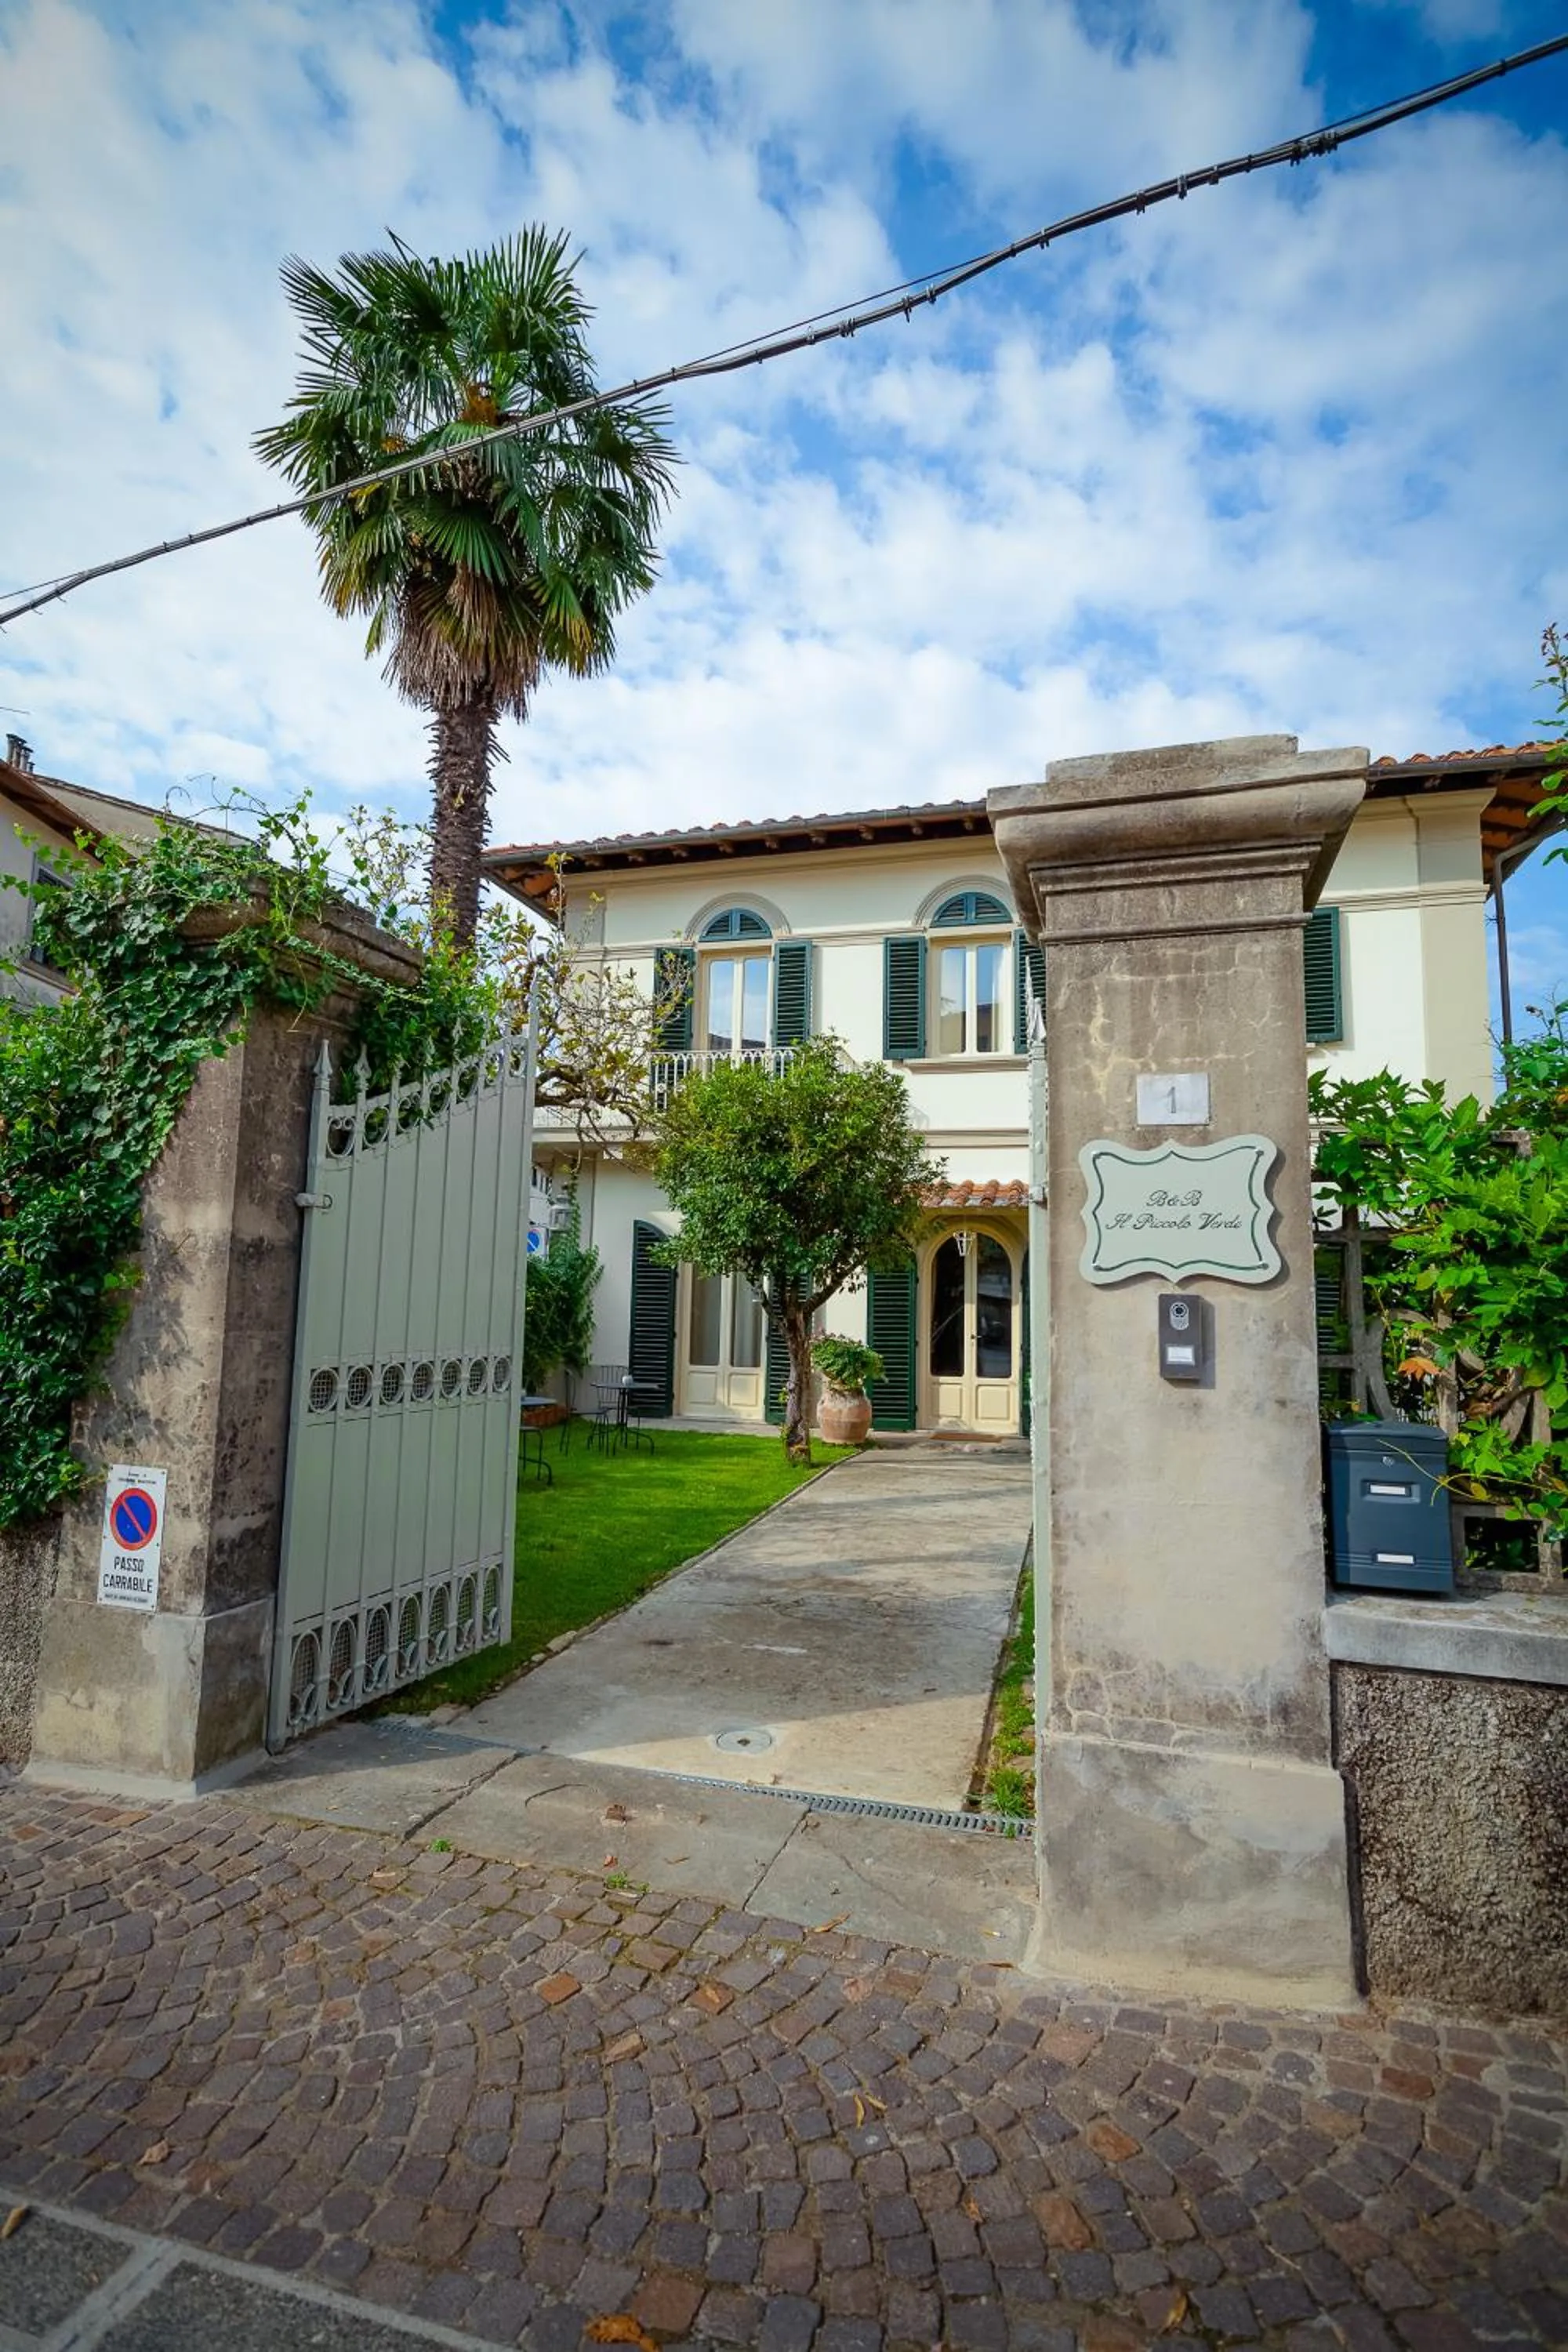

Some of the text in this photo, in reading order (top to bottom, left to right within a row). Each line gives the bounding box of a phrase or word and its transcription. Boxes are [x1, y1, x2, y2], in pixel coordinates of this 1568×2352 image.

[1167, 1087, 1176, 1113] 1
[1146, 1189, 1202, 1206] B&B
[1106, 1213, 1242, 1229] Il Piccolo Verde
[114, 1556, 144, 1572] PASSO
[103, 1574, 153, 1593] CARRABILE
